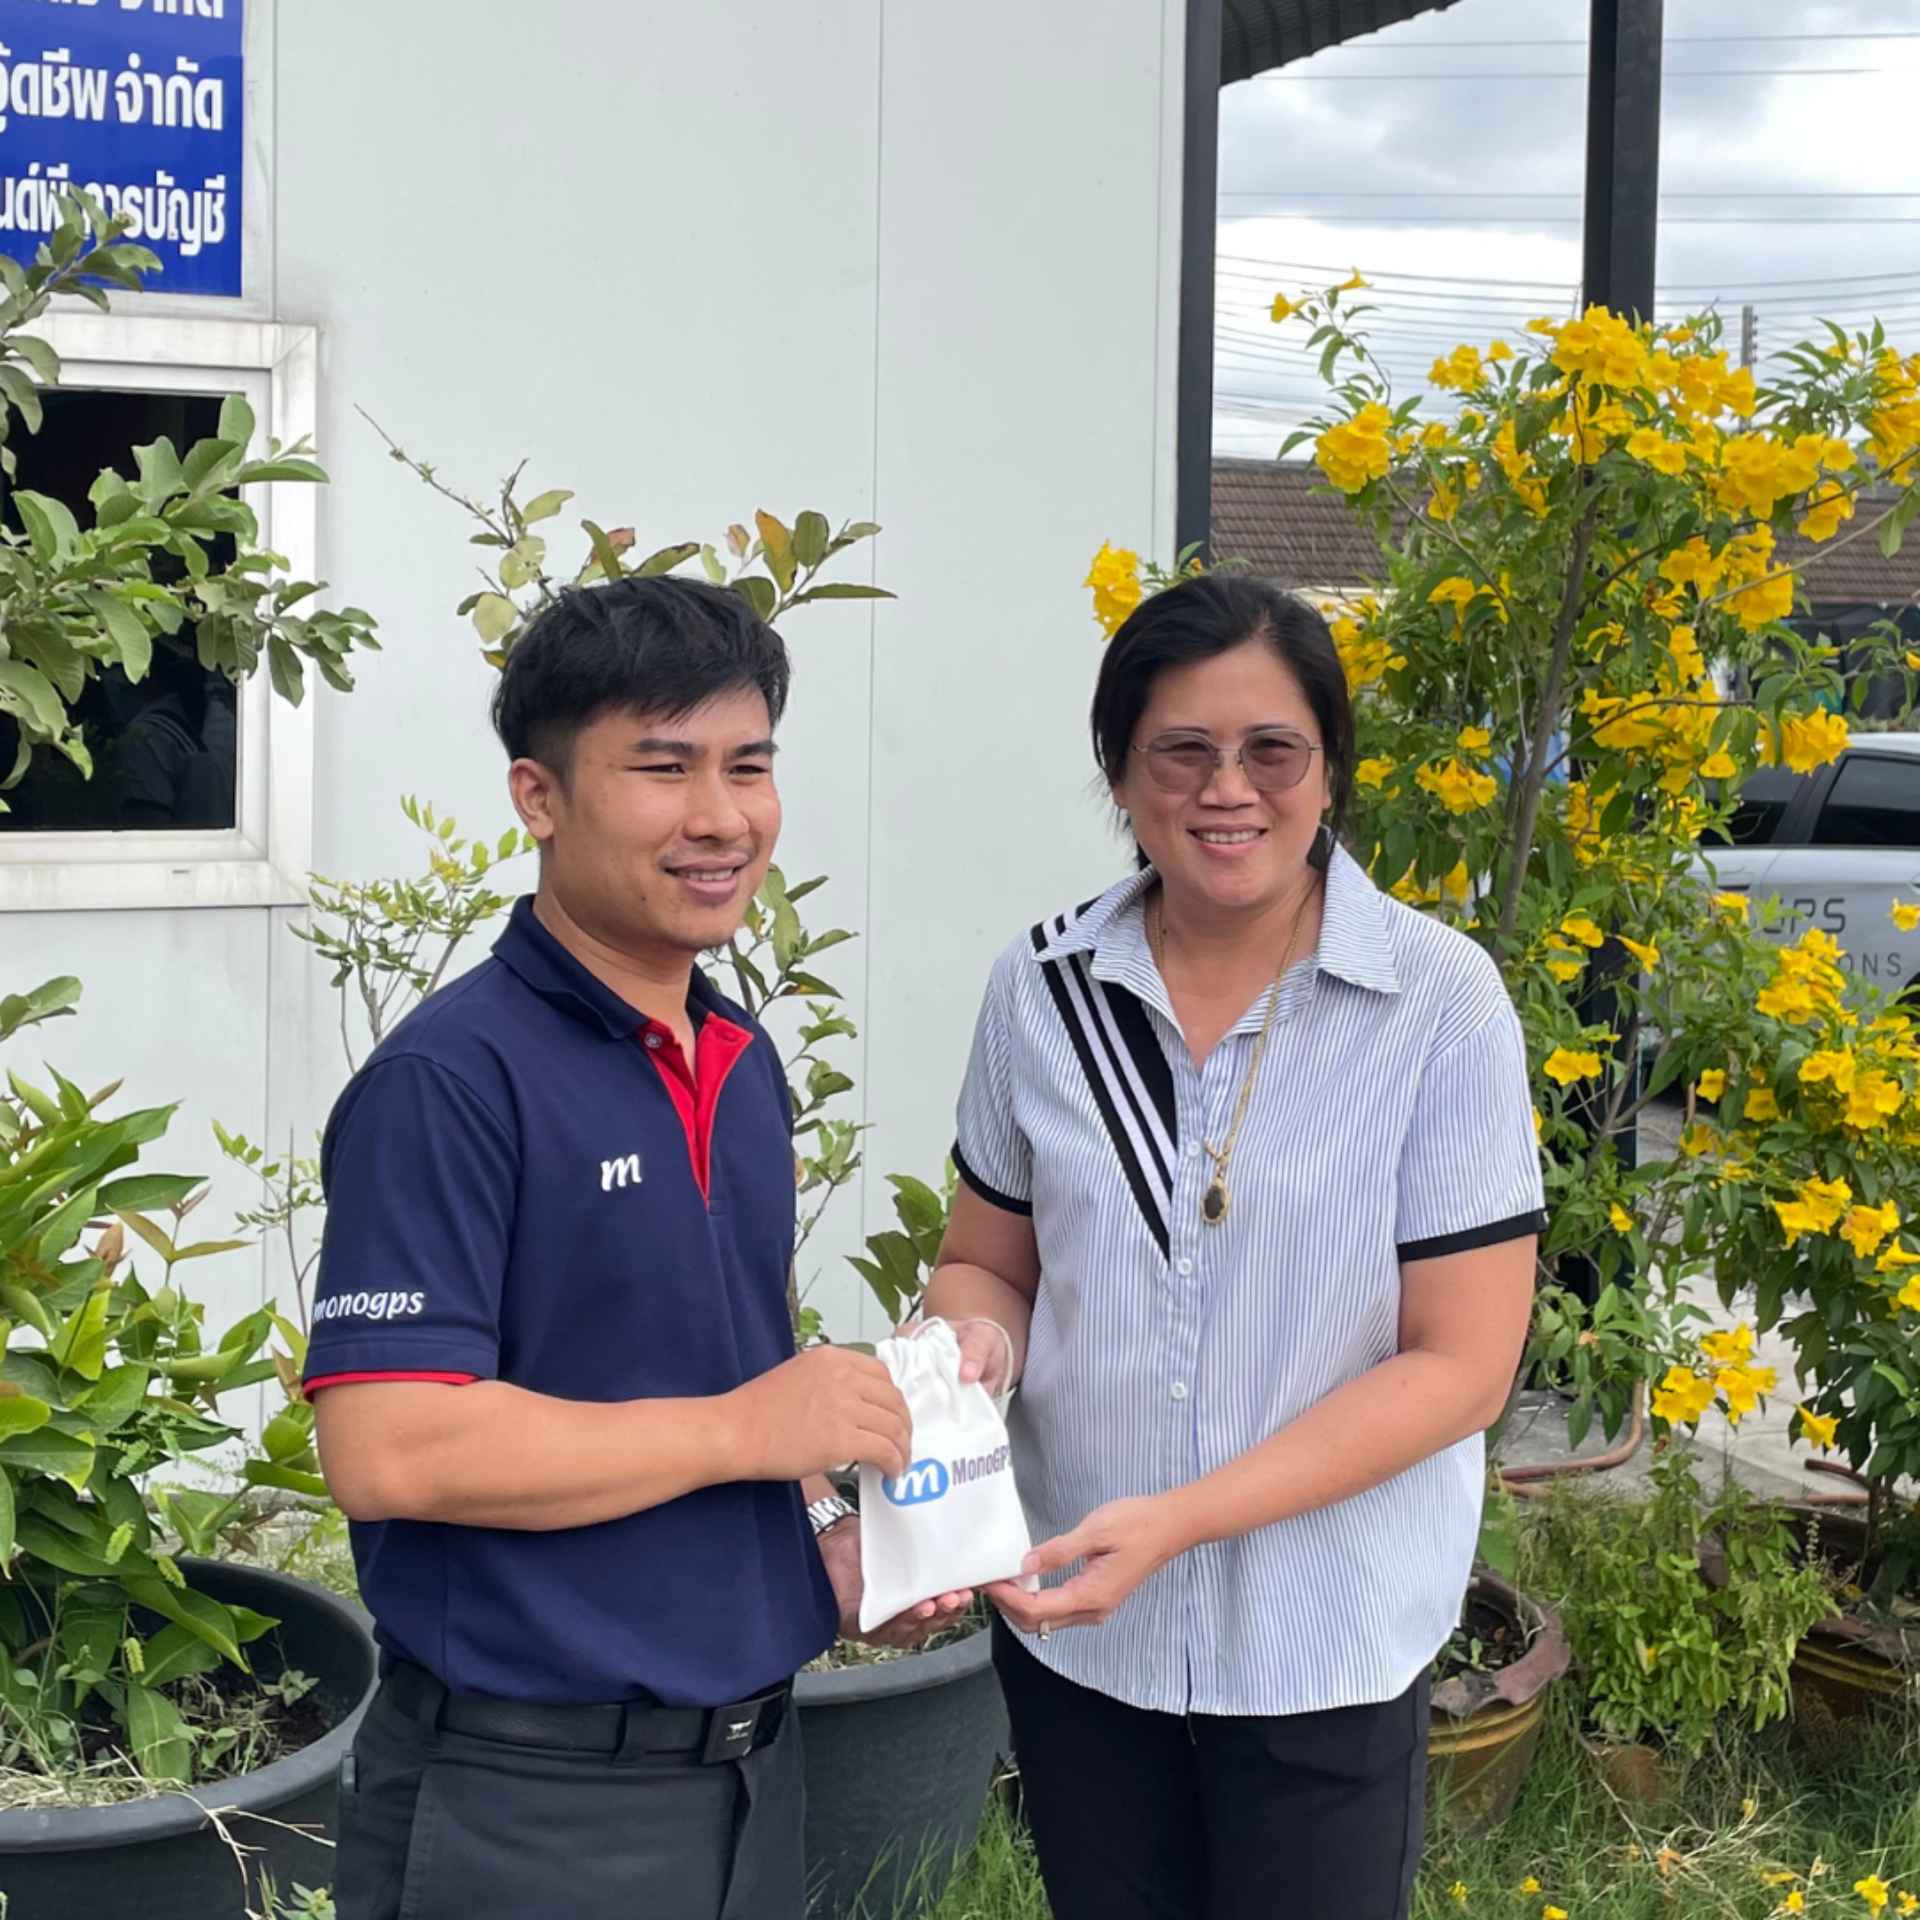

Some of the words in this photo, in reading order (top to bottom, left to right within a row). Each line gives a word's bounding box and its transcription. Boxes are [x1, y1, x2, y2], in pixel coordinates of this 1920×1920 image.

[115, 52, 223, 131] จำกัด
[601, 1154, 642, 1191] m
[312, 1291, 425, 1323] monogps
[951, 1444, 1011, 1486] MonoGP
